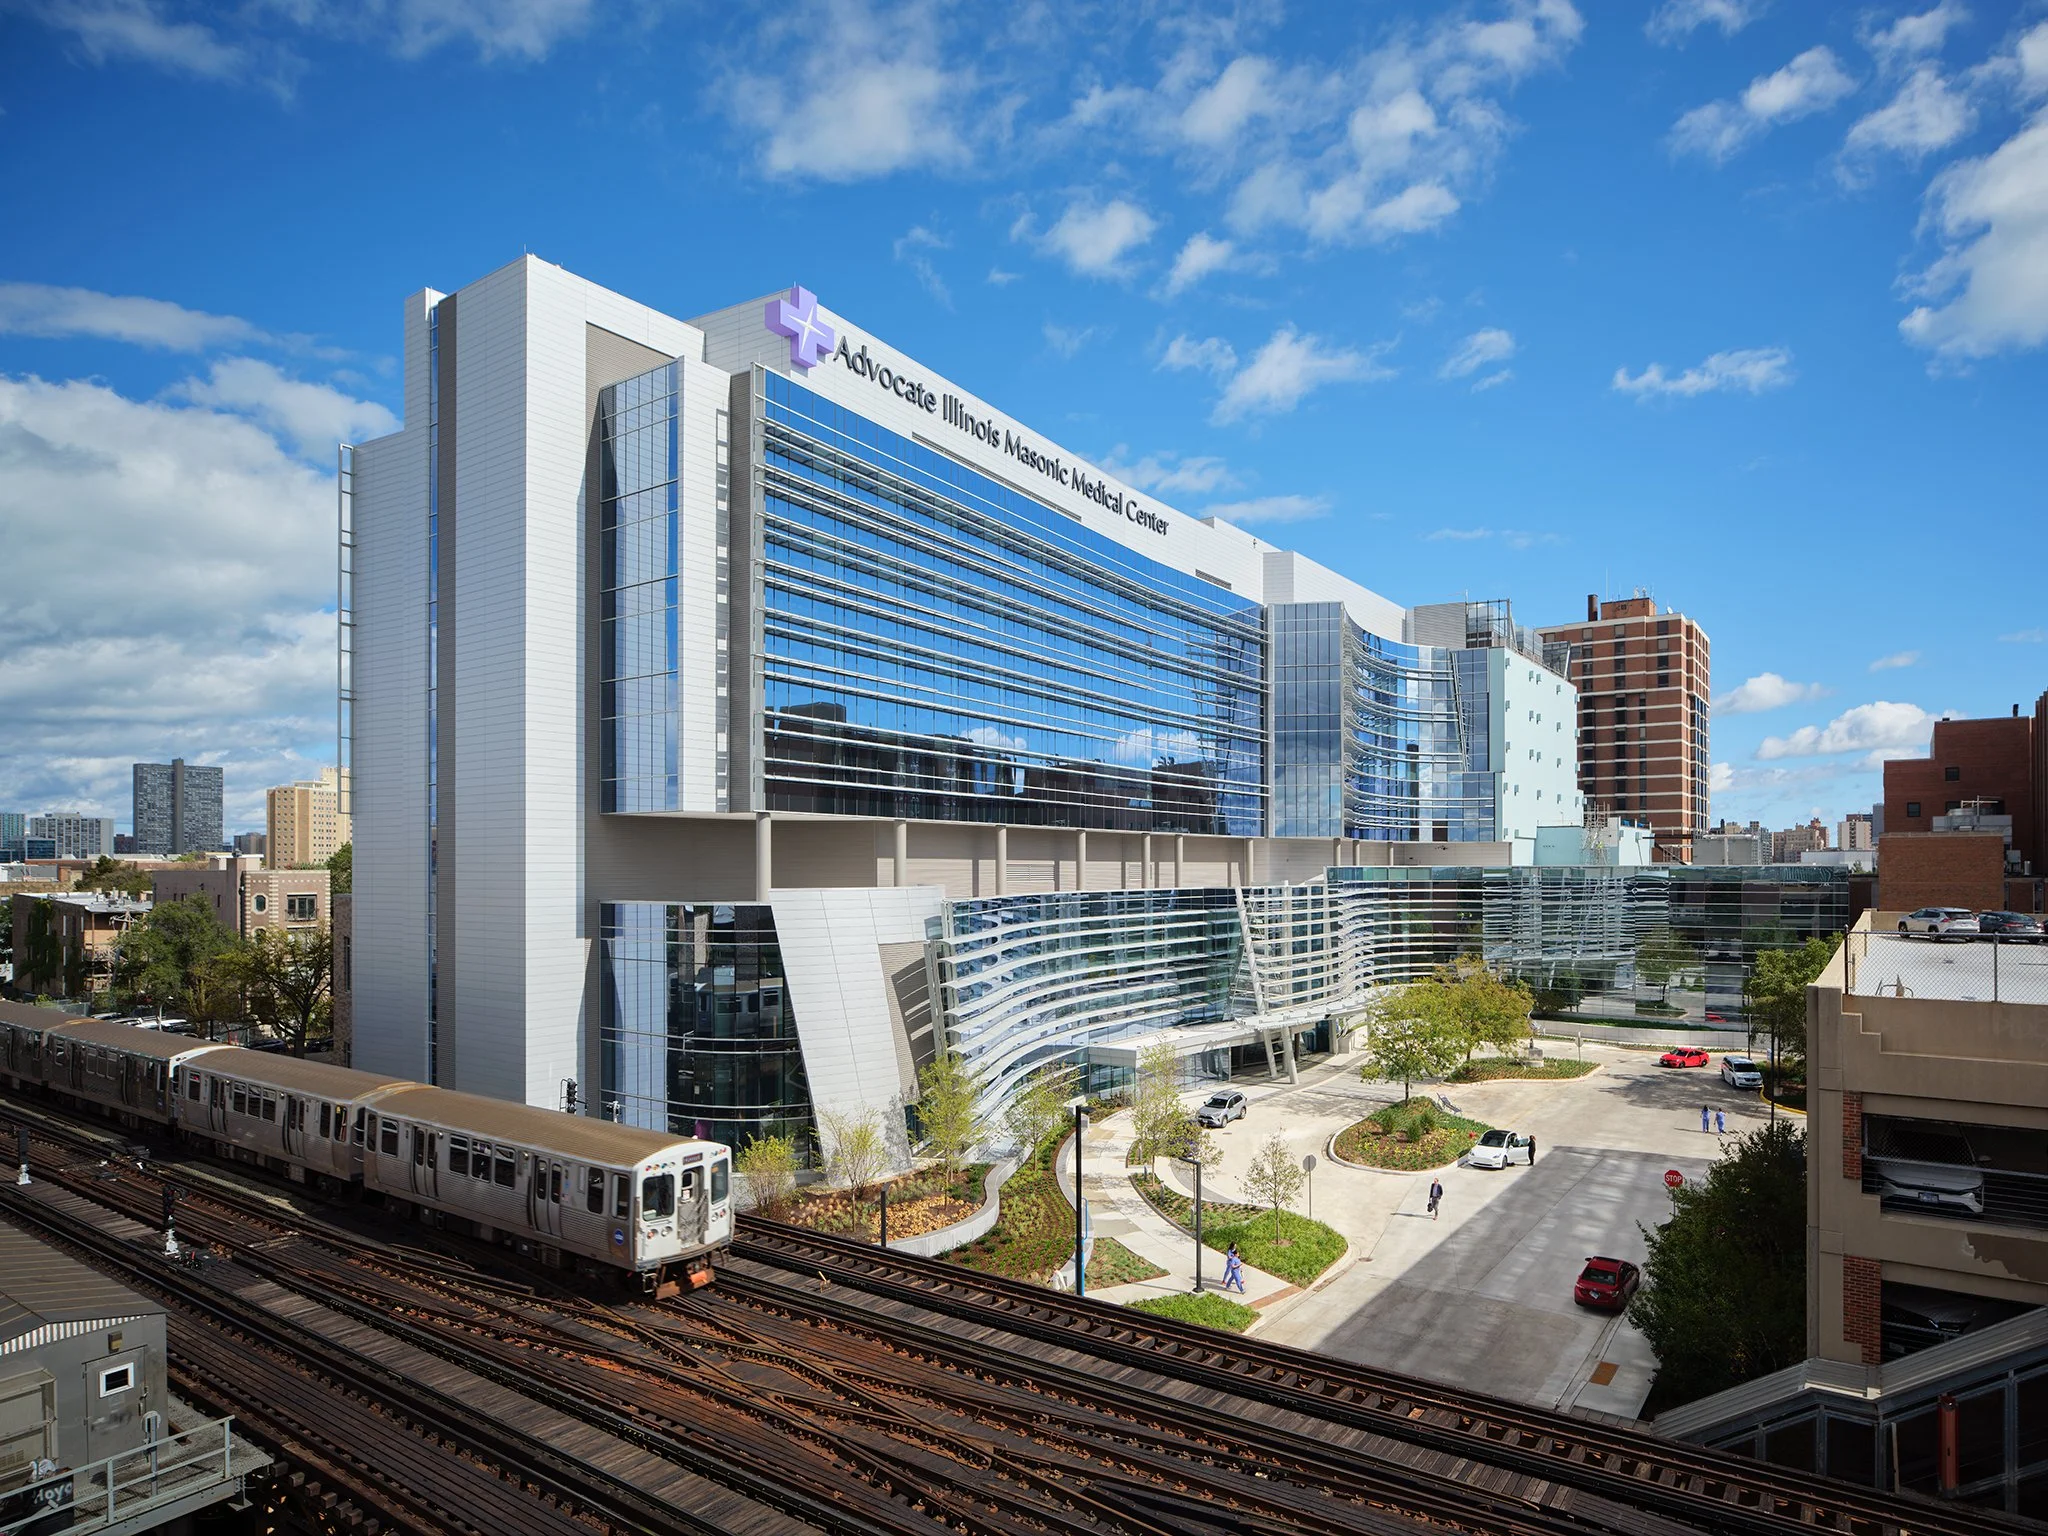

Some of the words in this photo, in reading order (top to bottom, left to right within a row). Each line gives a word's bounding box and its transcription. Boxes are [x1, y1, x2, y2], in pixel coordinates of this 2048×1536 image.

[833, 335, 937, 415] Advocate
[942, 393, 1001, 449] Illinois
[1004, 429, 1069, 486] Masonic
[1071, 467, 1123, 516] Medical
[1125, 499, 1170, 536] Center
[1665, 1174, 1682, 1183] STOP
